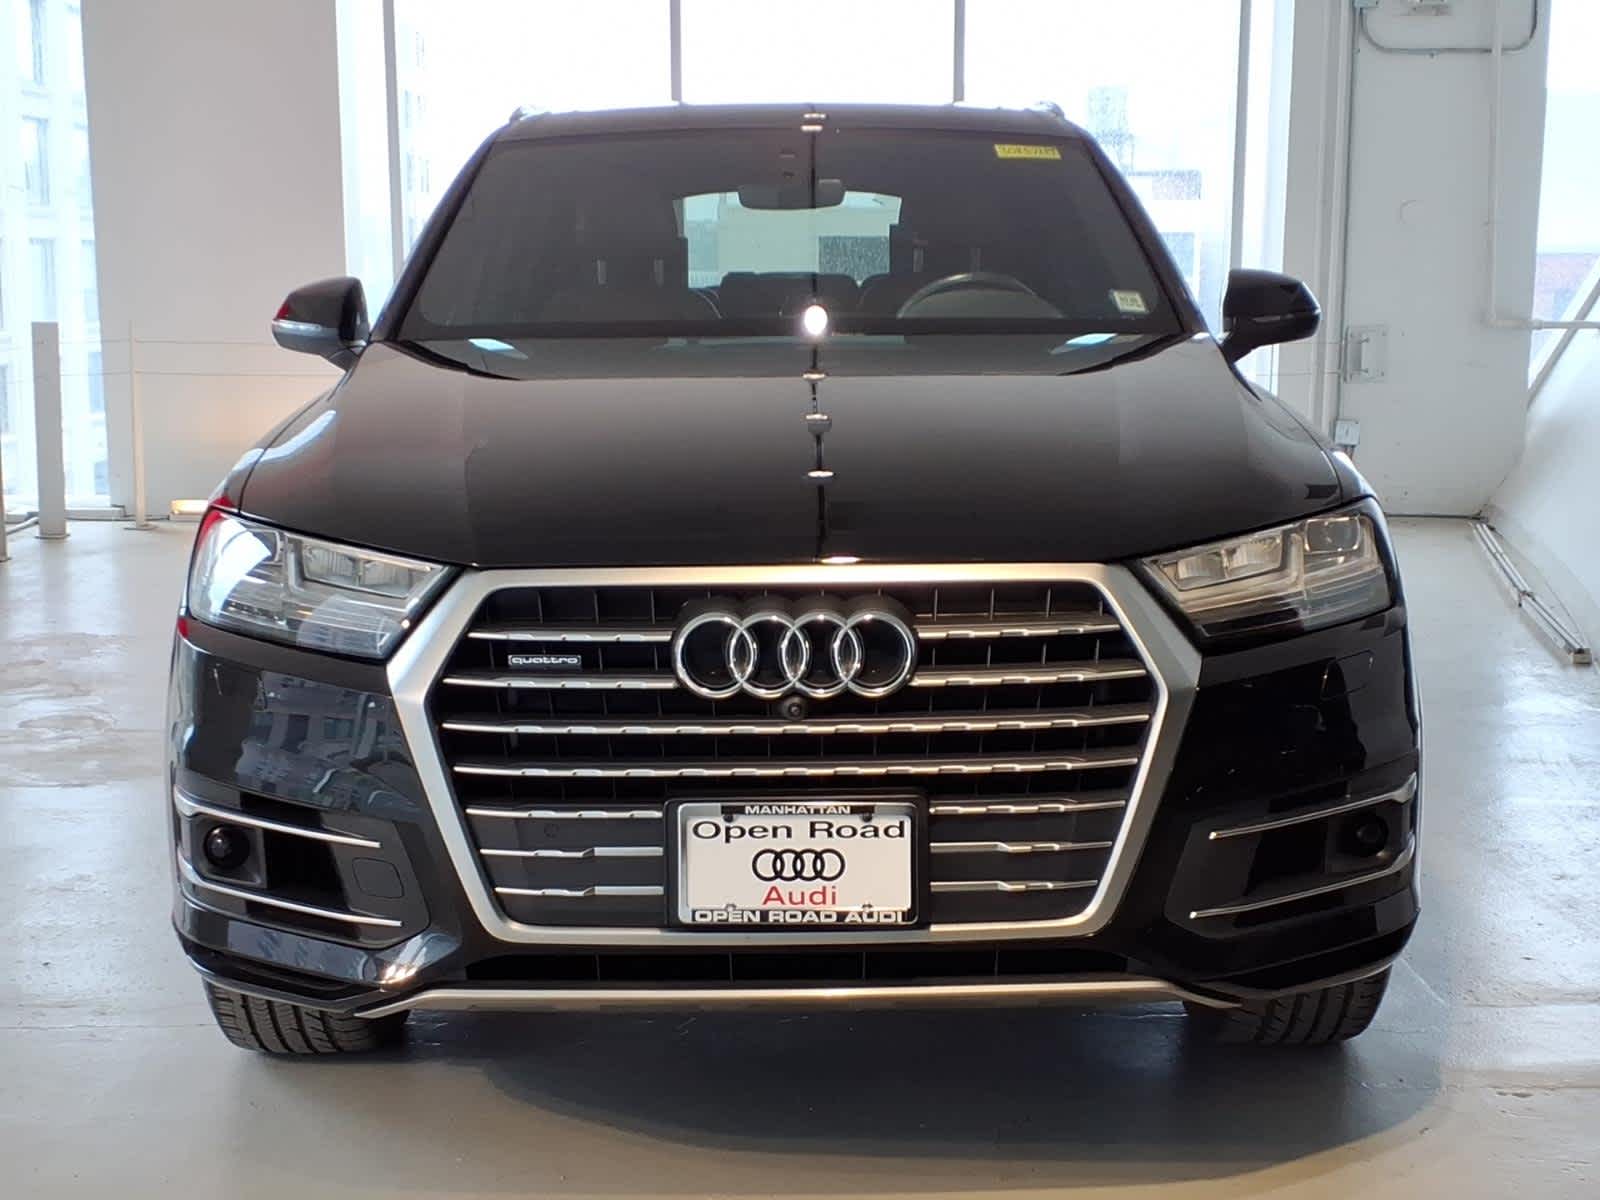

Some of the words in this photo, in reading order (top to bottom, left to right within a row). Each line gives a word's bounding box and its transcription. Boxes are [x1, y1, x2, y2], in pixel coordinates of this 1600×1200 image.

[511, 656, 578, 664] quattro
[745, 805, 851, 814] MANHATTAN
[692, 821, 793, 843] Open
[809, 820, 905, 838] Road
[762, 885, 837, 905] Audi
[695, 910, 761, 923] OPEN
[768, 910, 838, 923] ROAD
[844, 910, 903, 923] AUDI
